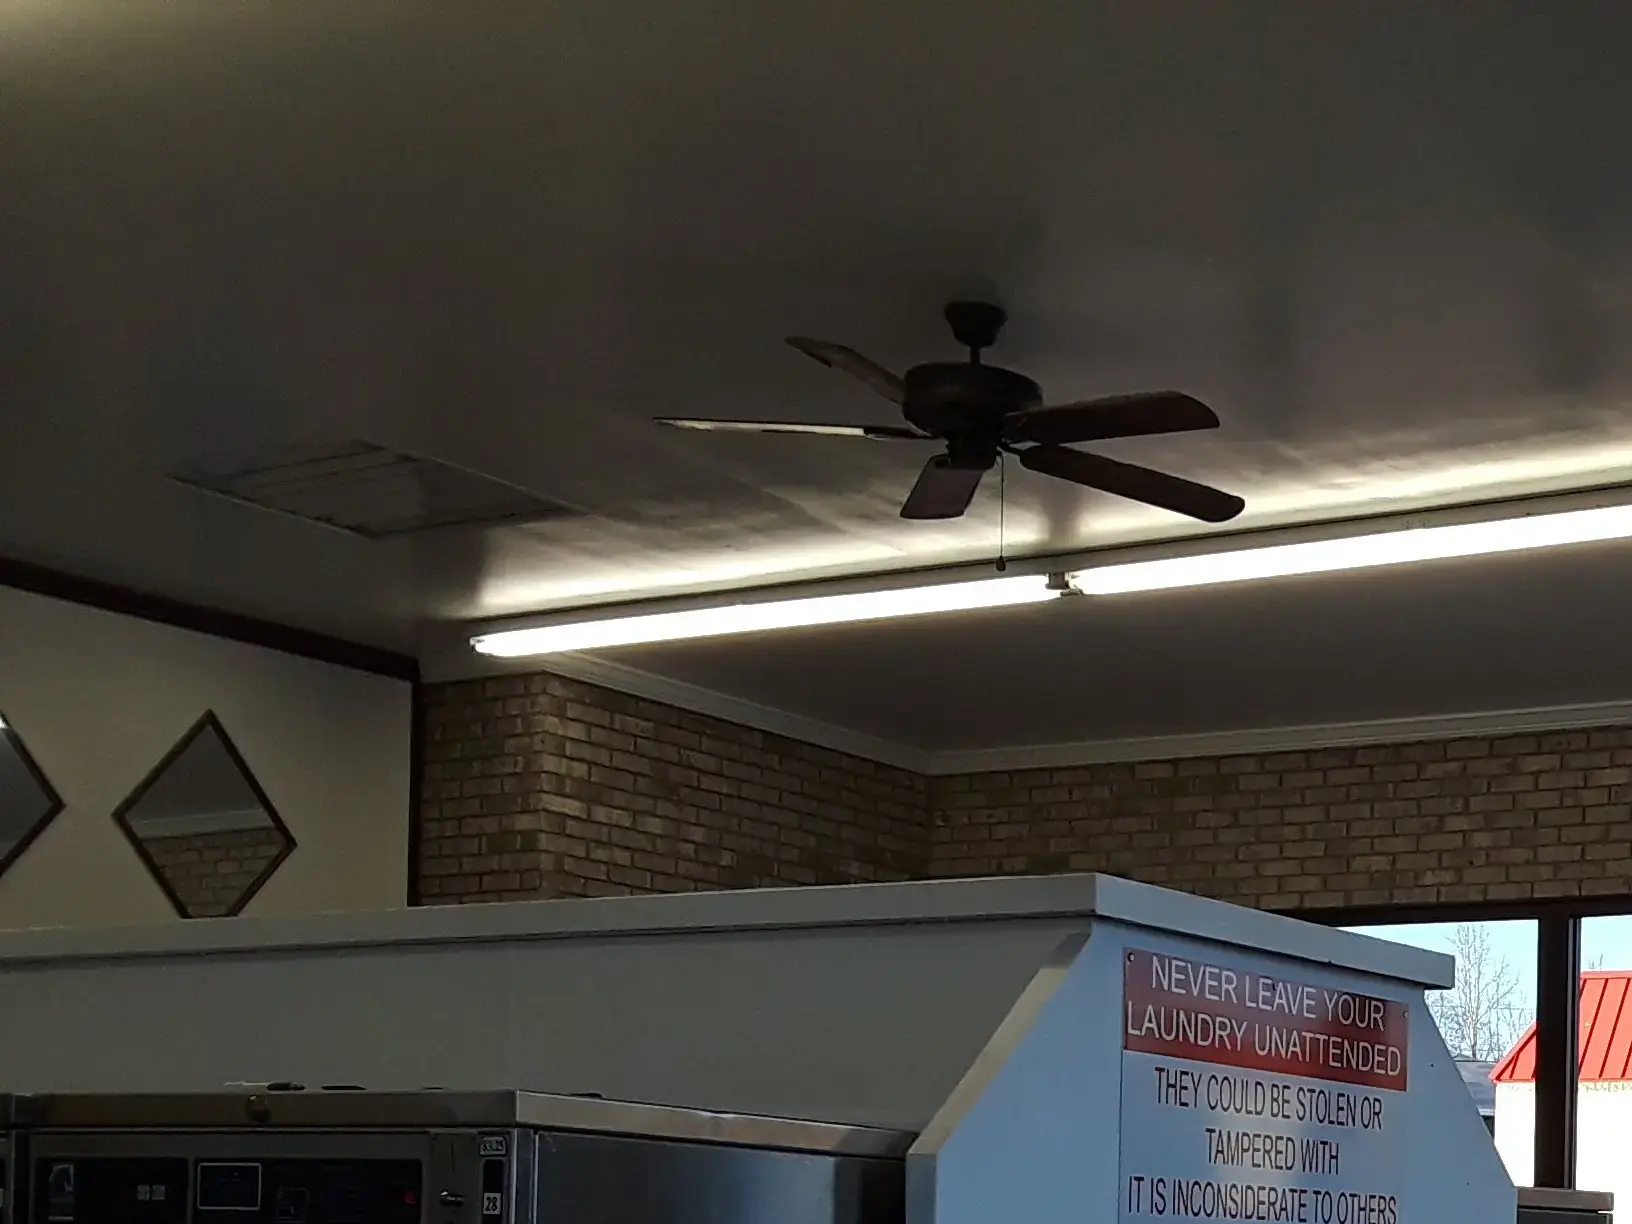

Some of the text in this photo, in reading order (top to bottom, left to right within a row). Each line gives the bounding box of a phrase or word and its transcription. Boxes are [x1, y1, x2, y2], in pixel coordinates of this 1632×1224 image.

[1151, 956, 1385, 1031] NEVER LEAVE YOUR
[1127, 1001, 1401, 1076] LAUNDRY UNATTENDED
[1155, 1067, 1382, 1130] THEY COULD BE STOLEN OR
[1205, 1128, 1339, 1175] TAMPERED WITH
[486, 1196, 498, 1212] 28
[1128, 1176, 1145, 1213] IT
[1151, 1178, 1167, 1215] IS
[1172, 1179, 1308, 1223] INCONSIDERATE
[1312, 1190, 1333, 1224] TO
